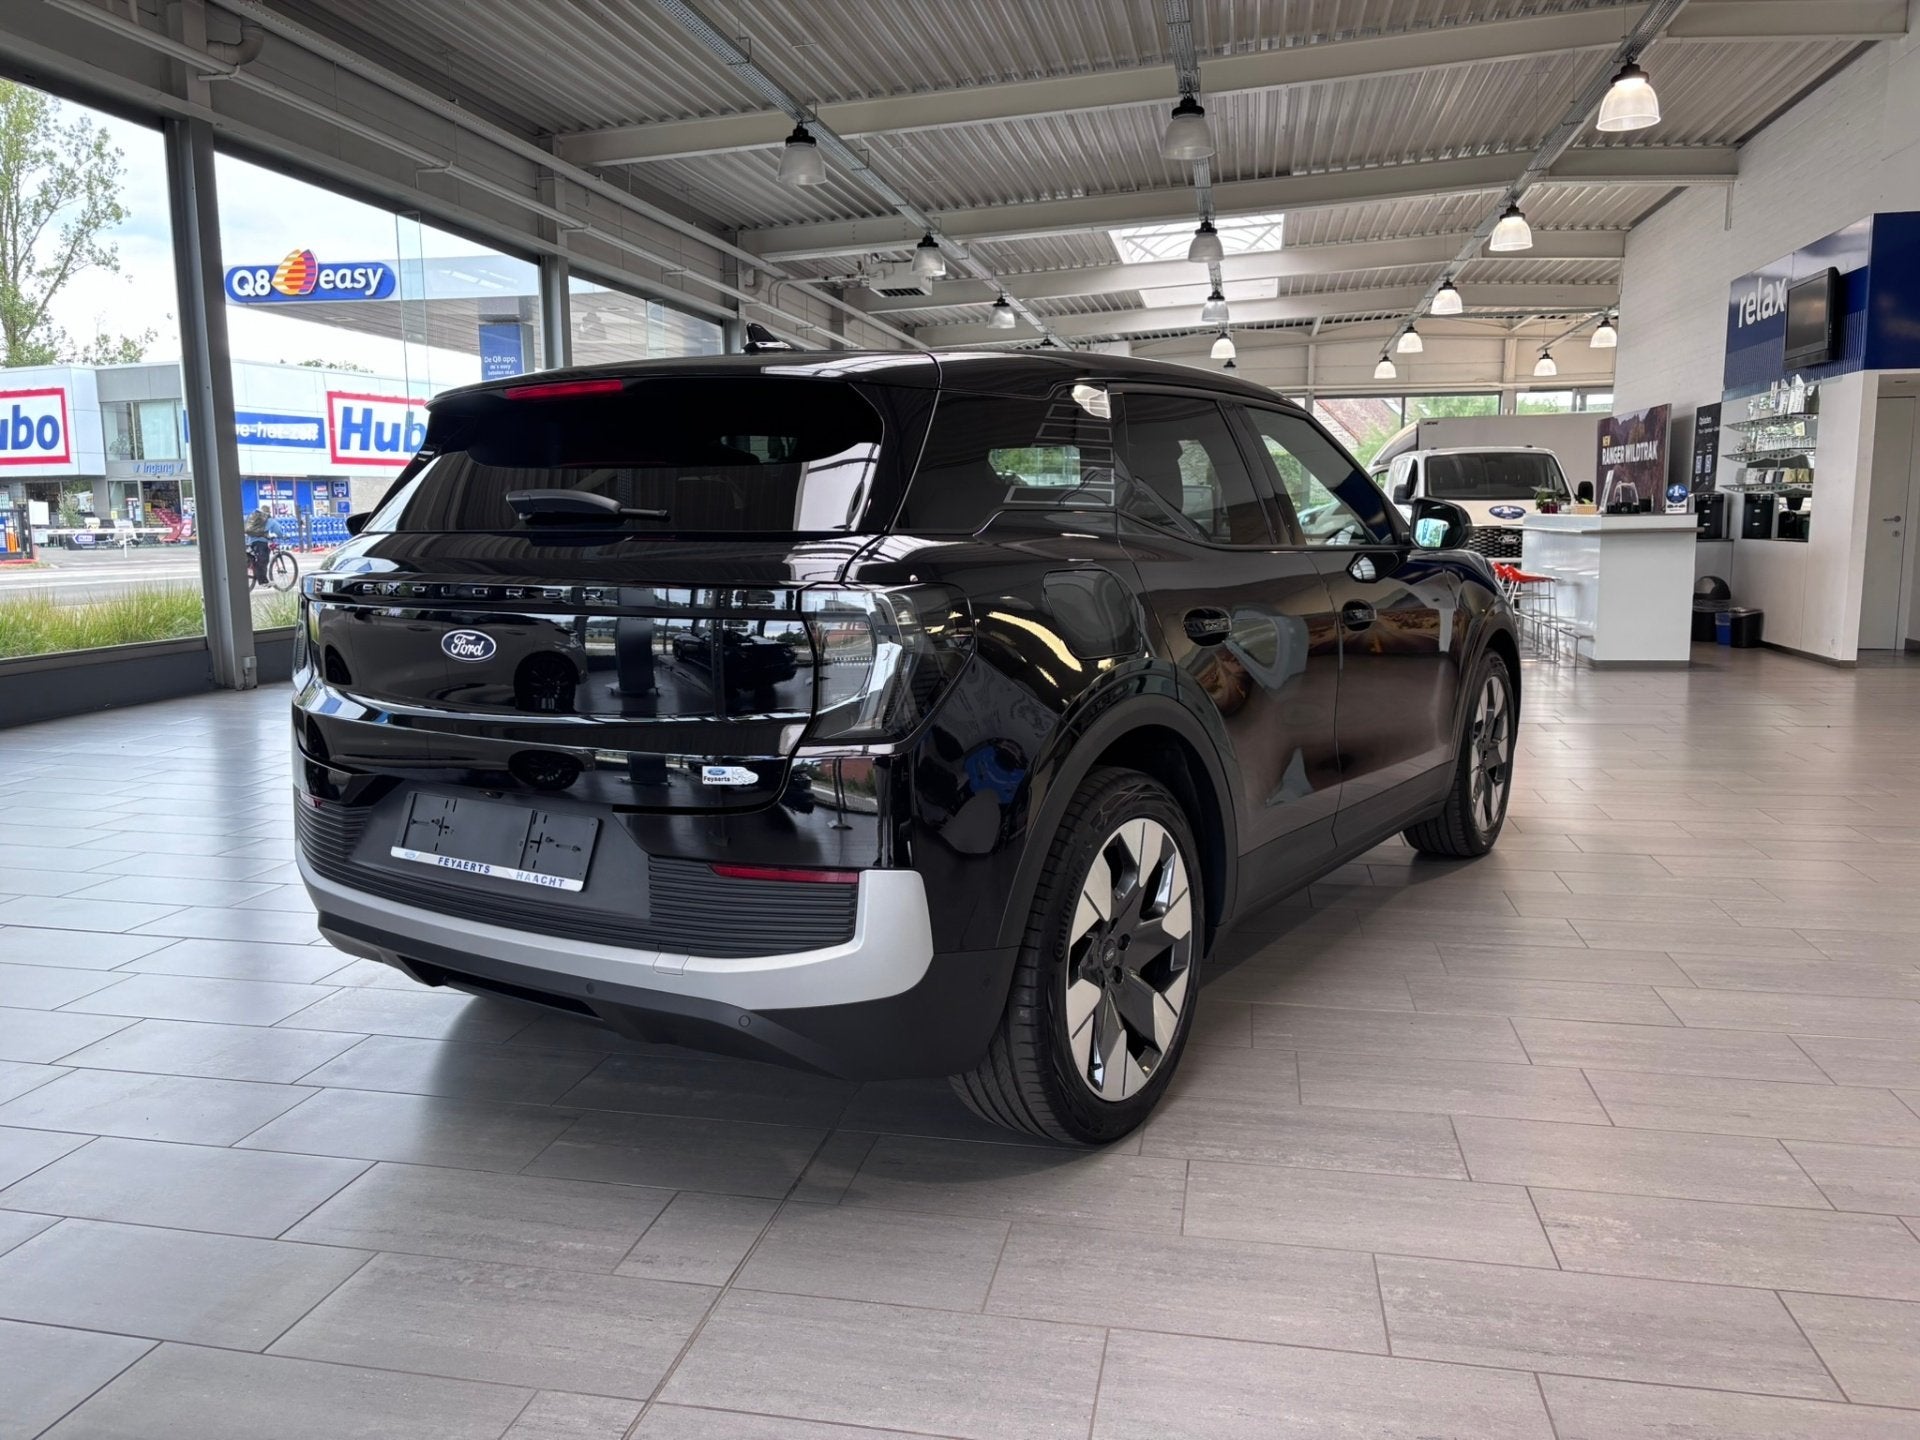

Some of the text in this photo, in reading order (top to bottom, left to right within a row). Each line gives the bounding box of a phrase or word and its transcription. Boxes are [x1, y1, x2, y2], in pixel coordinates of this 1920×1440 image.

[232, 267, 384, 297] Q8 easy
[1738, 277, 1787, 328] relax
[340, 406, 427, 452] Hub
[1601, 440, 1659, 466] RANGER WILDTRAK
[437, 856, 566, 888] FEYAERTS HAACHT
